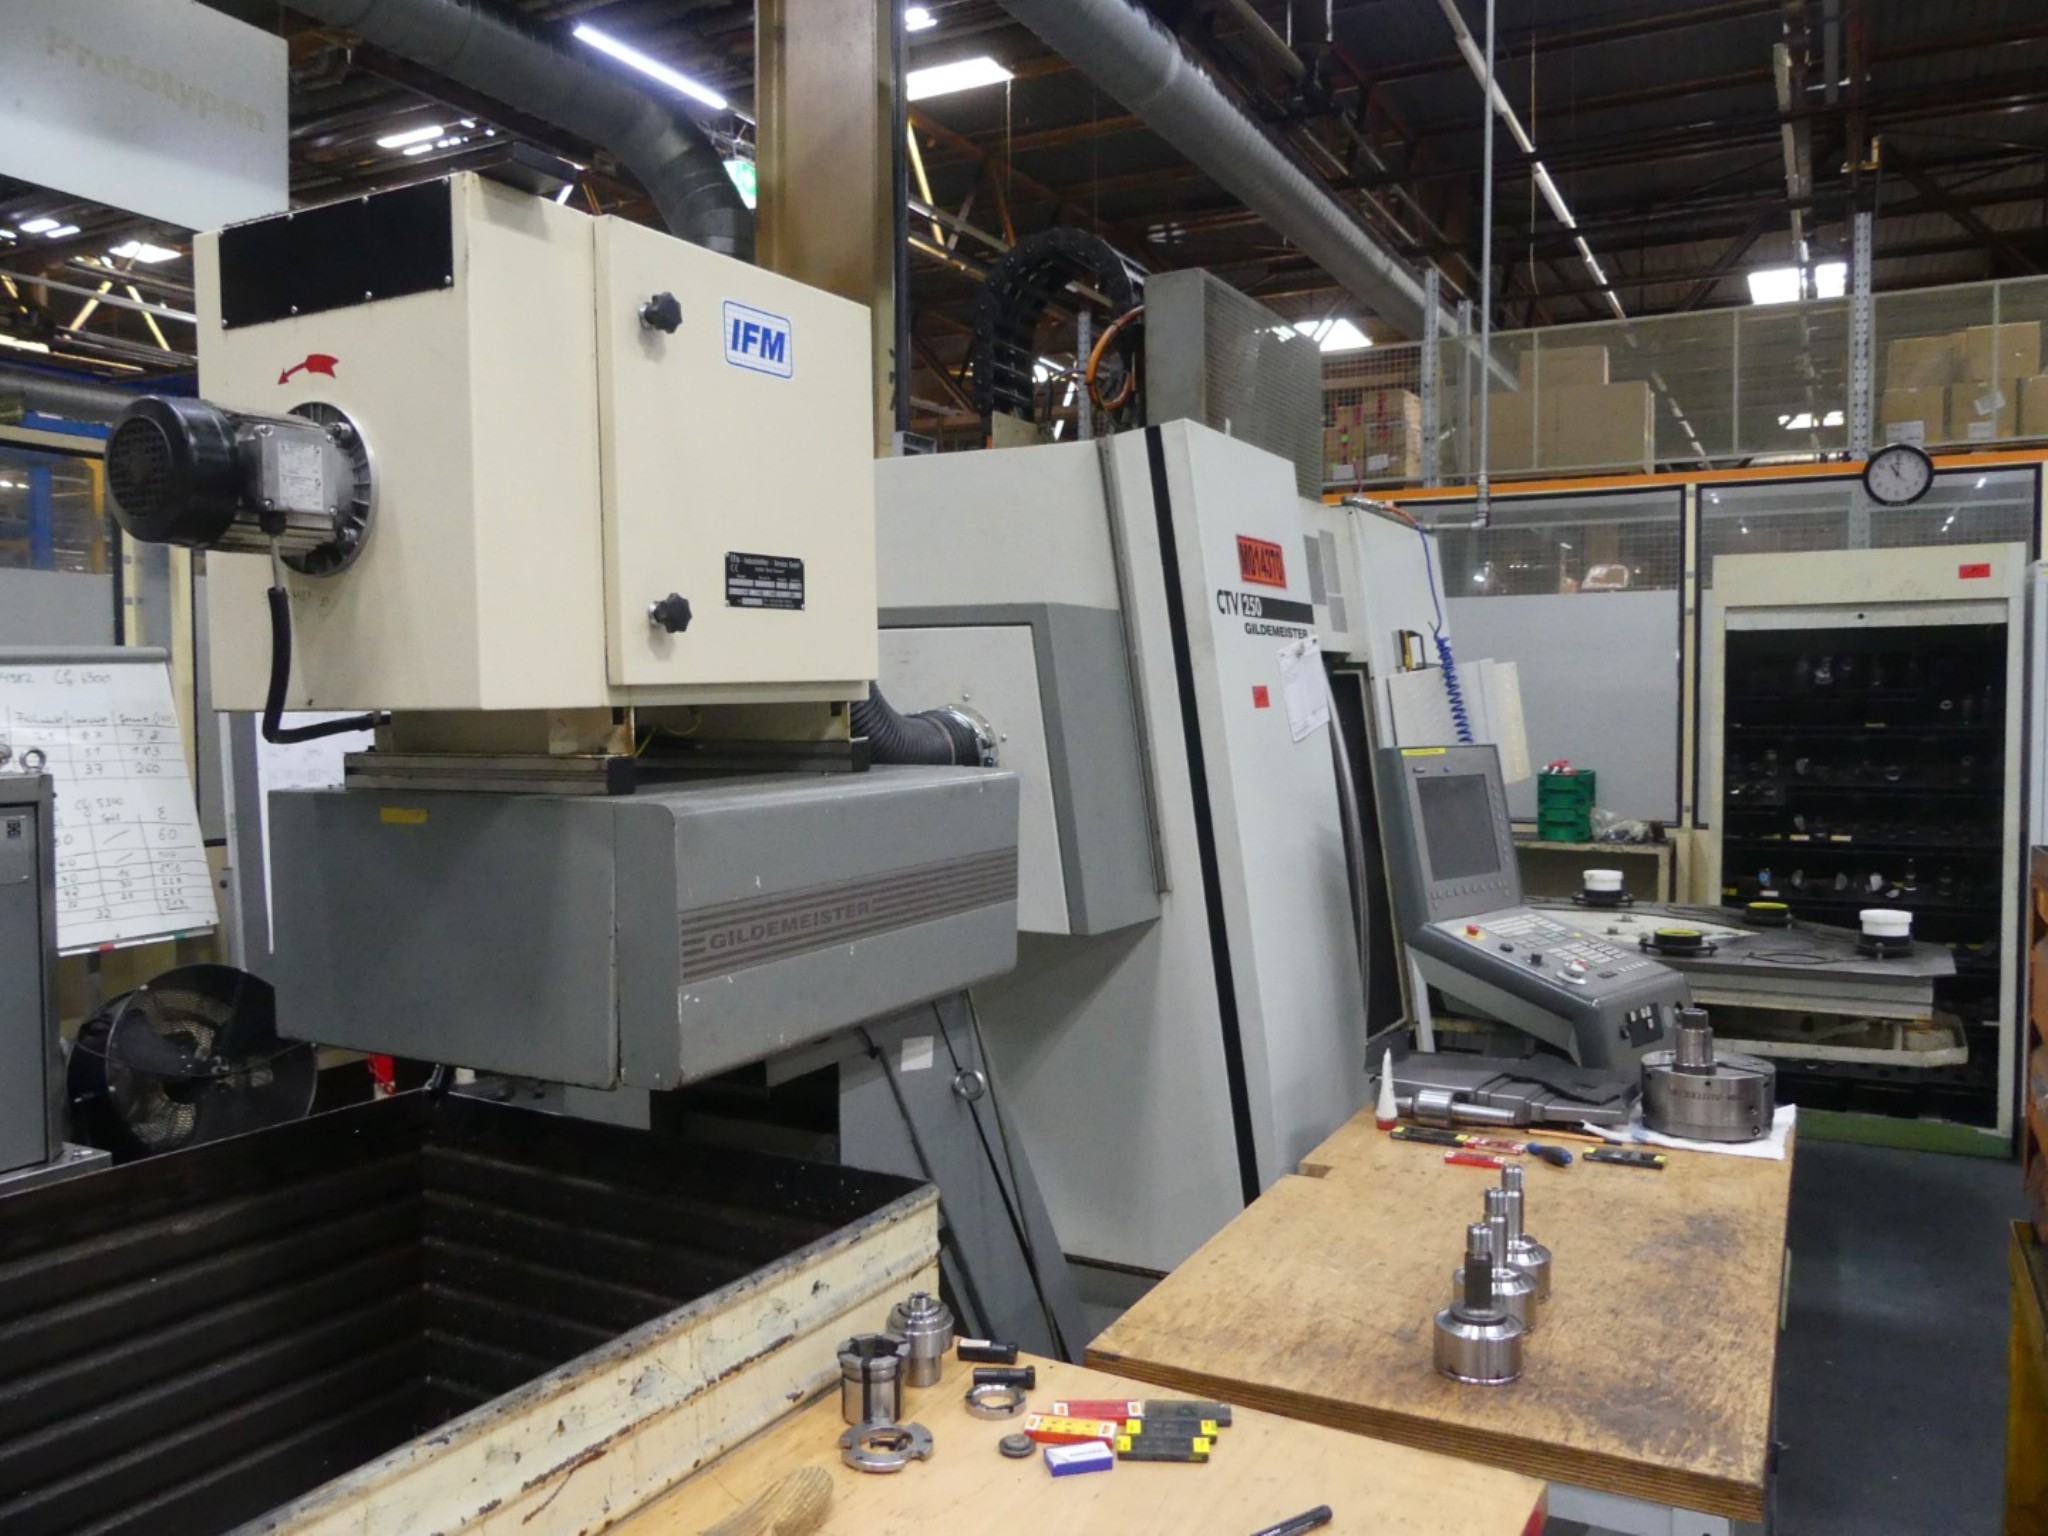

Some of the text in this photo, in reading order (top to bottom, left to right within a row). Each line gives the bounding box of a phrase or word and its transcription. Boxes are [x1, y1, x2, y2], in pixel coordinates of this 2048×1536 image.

[731, 318, 785, 364] IFM
[1217, 589, 1263, 617] CTV 250
[1245, 622, 1308, 639] GILDEMEISTER
[708, 901, 874, 951] GILDEMEISTER
